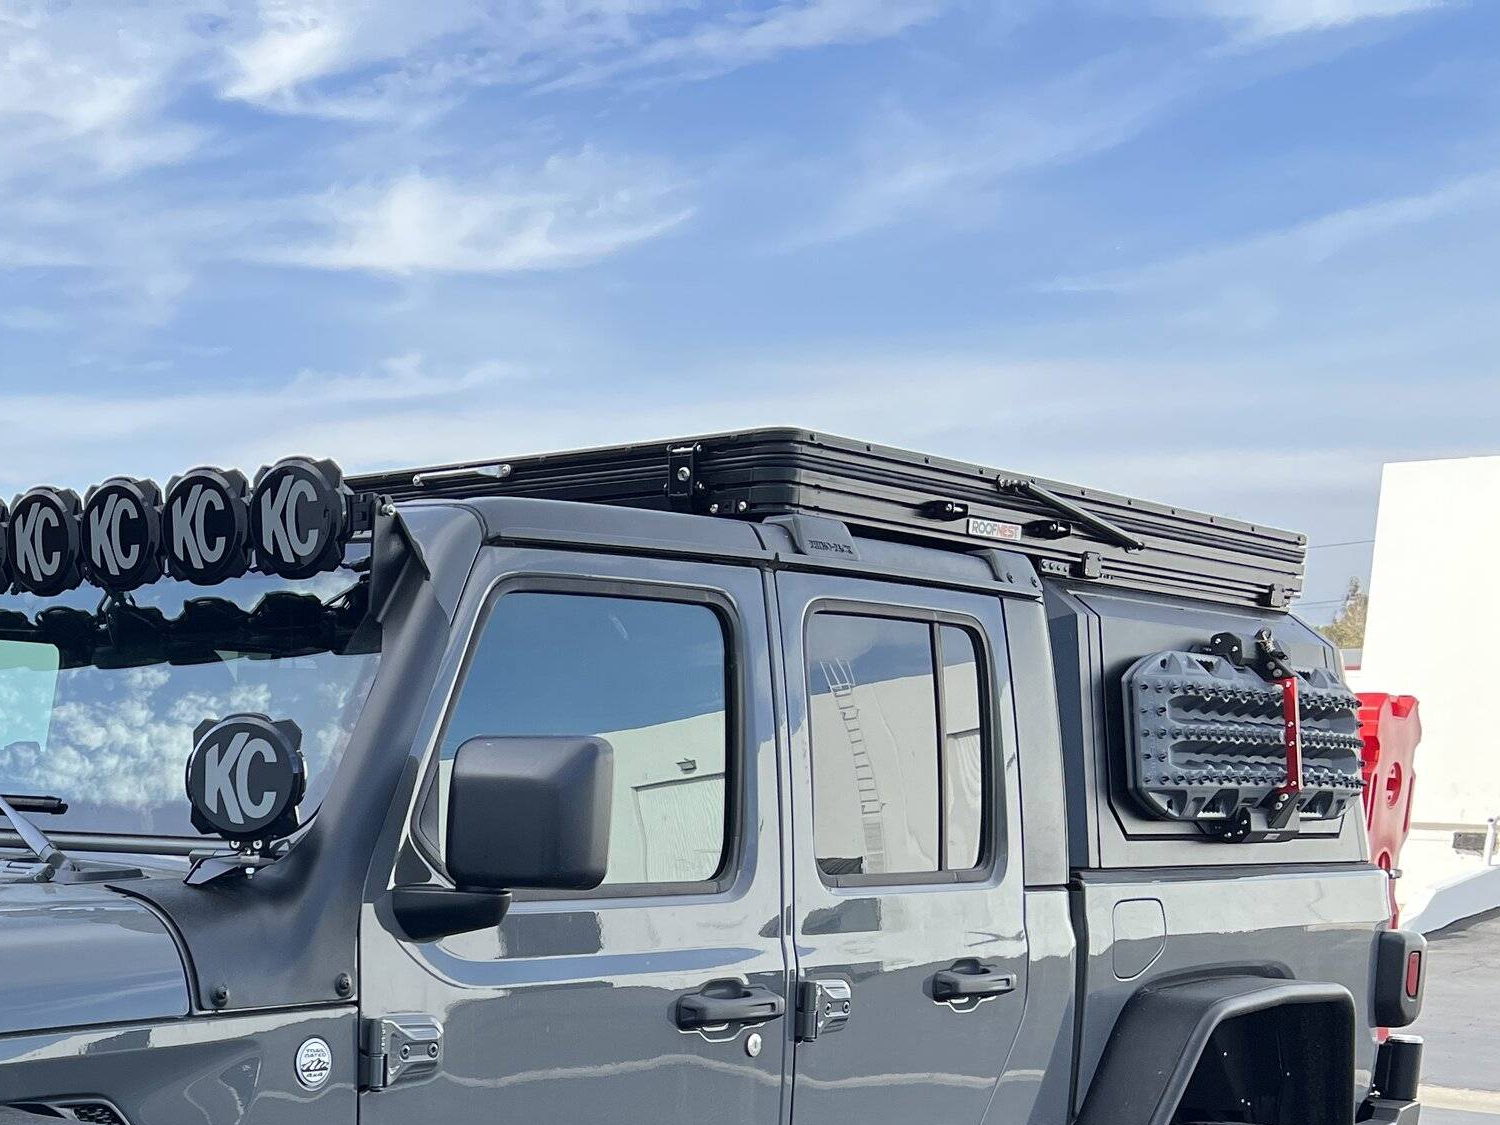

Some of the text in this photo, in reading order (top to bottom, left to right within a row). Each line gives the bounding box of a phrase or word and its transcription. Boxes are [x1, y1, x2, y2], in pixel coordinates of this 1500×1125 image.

[15, 502, 60, 581] KC
[90, 493, 139, 575] KC
[172, 484, 226, 569] KC
[262, 475, 319, 563] KC
[971, 520, 1019, 539] ROOFNEST
[205, 732, 277, 824] KC
